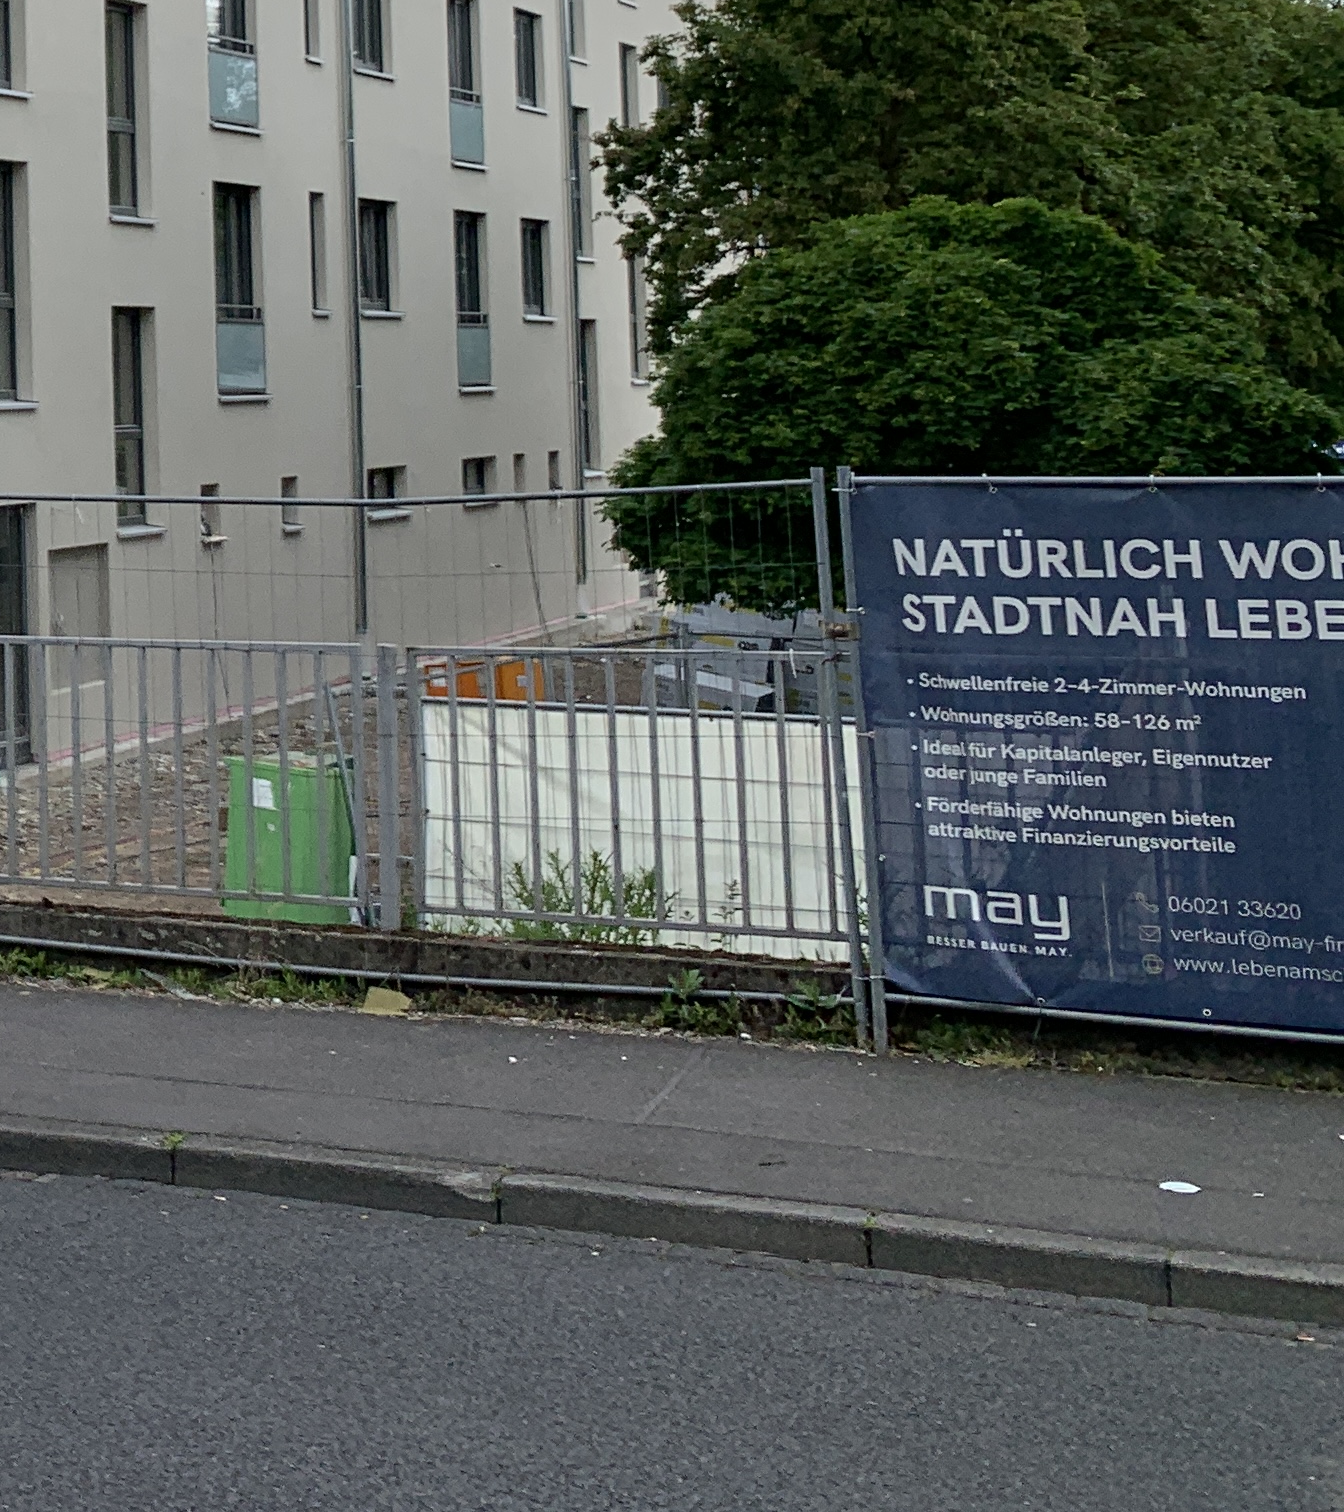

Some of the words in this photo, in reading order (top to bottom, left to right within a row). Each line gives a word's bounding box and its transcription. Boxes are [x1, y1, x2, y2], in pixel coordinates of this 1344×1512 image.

[892, 529, 1203, 579] NATÜRLICH
[902, 594, 1187, 638] STADTNAH
[919, 672, 1049, 693] Schwellenfreie
[920, 705, 1089, 730] Wohnungsgrößen:
[1175, 714, 1203, 731] m²
[923, 739, 965, 757] Ideal
[968, 741, 997, 759] für
[1001, 743, 1148, 767] Kapitalanleger,
[1152, 748, 1273, 770] Eigennutzer
[924, 764, 967, 782] oder
[968, 768, 1019, 788] junge
[1023, 769, 1108, 788] Familien
[926, 796, 1044, 823] Förderfähige
[1047, 804, 1167, 828] Wohnungen
[1171, 809, 1237, 828] bieten
[928, 822, 1018, 843] attraktive
[1021, 827, 1238, 854] Finanzierungsvorteile
[922, 885, 1071, 941] may
[1168, 896, 1230, 916] 06021
[1237, 900, 1303, 921] 33620
[926, 934, 977, 950] BESSER
[1034, 945, 1074, 958] MAY.
